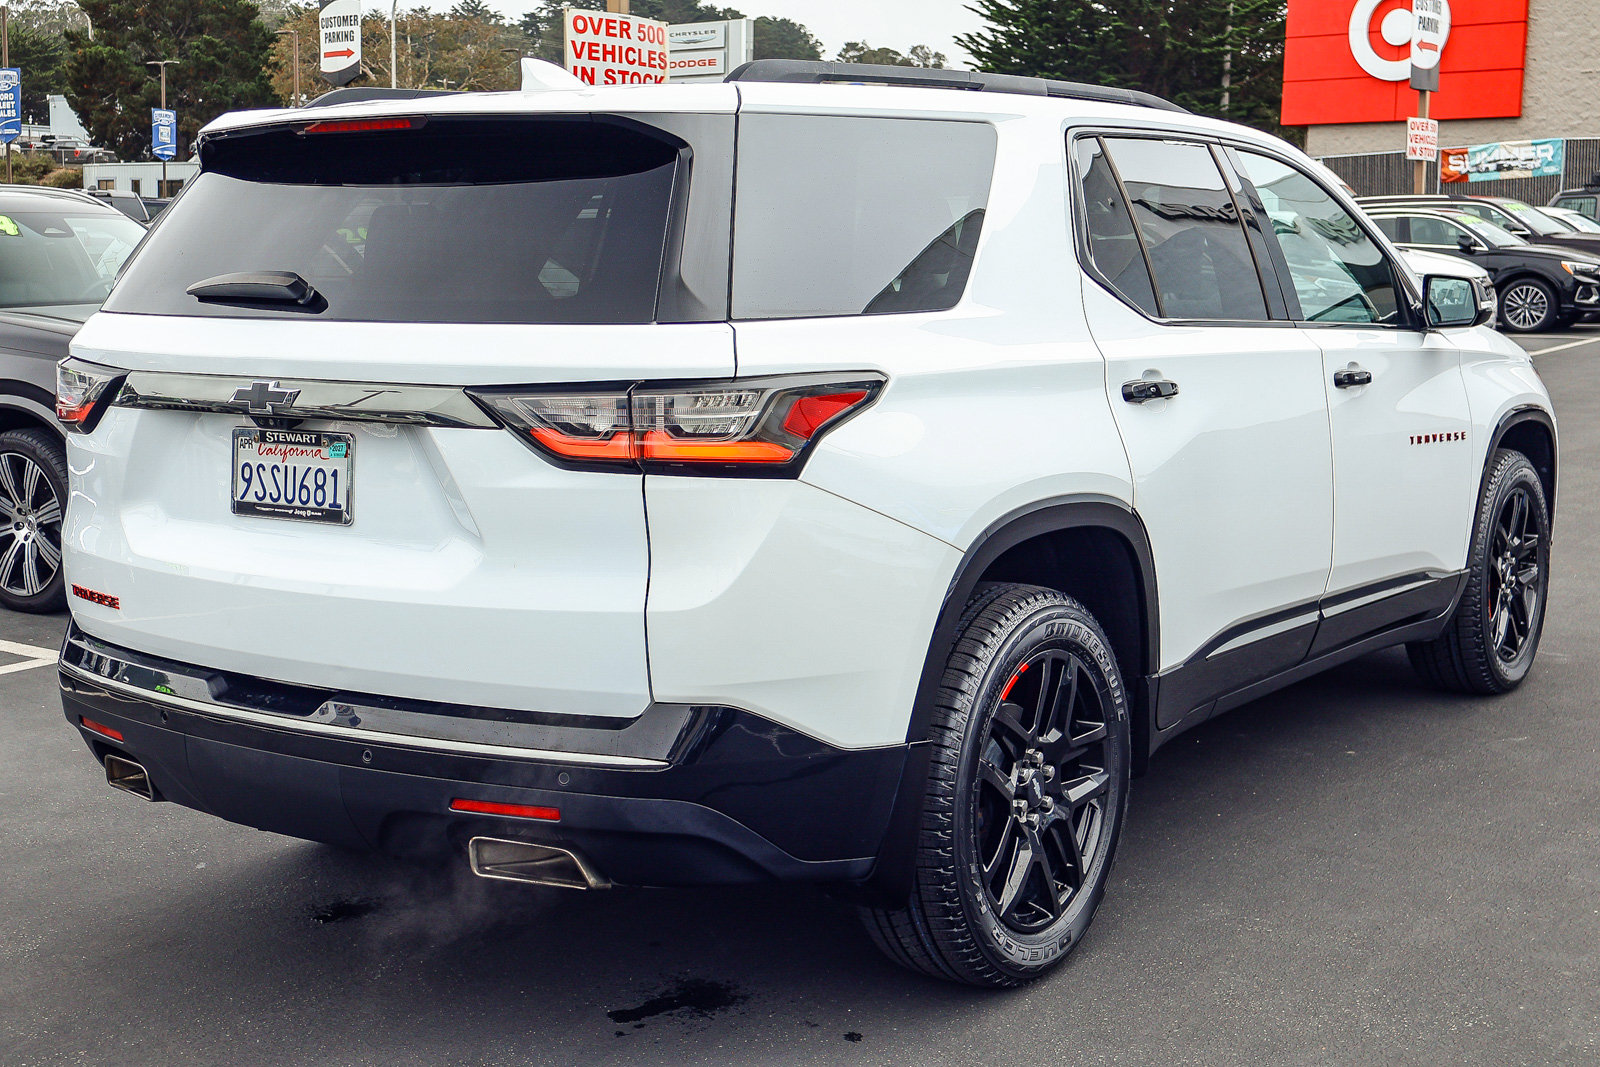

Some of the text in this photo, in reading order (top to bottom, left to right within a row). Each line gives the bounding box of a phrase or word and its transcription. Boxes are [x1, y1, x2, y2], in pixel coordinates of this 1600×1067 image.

[320, 15, 359, 29] CUSTOMER
[572, 14, 665, 45] OVER 500
[669, 29, 717, 37] CHRYSLER
[325, 30, 355, 44] PARKING
[570, 40, 668, 70] VEHICLES
[670, 58, 717, 69] DODGE
[572, 65, 665, 85] IN STOCK
[0, 93, 15, 101] ORD
[266, 432, 317, 443] STEWART
[1409, 431, 1466, 445] TRAVERSE
[239, 437, 254, 449] APR
[258, 443, 330, 463] California
[239, 461, 342, 509] 9SSU681
[71, 583, 120, 610] TRAVERSE
